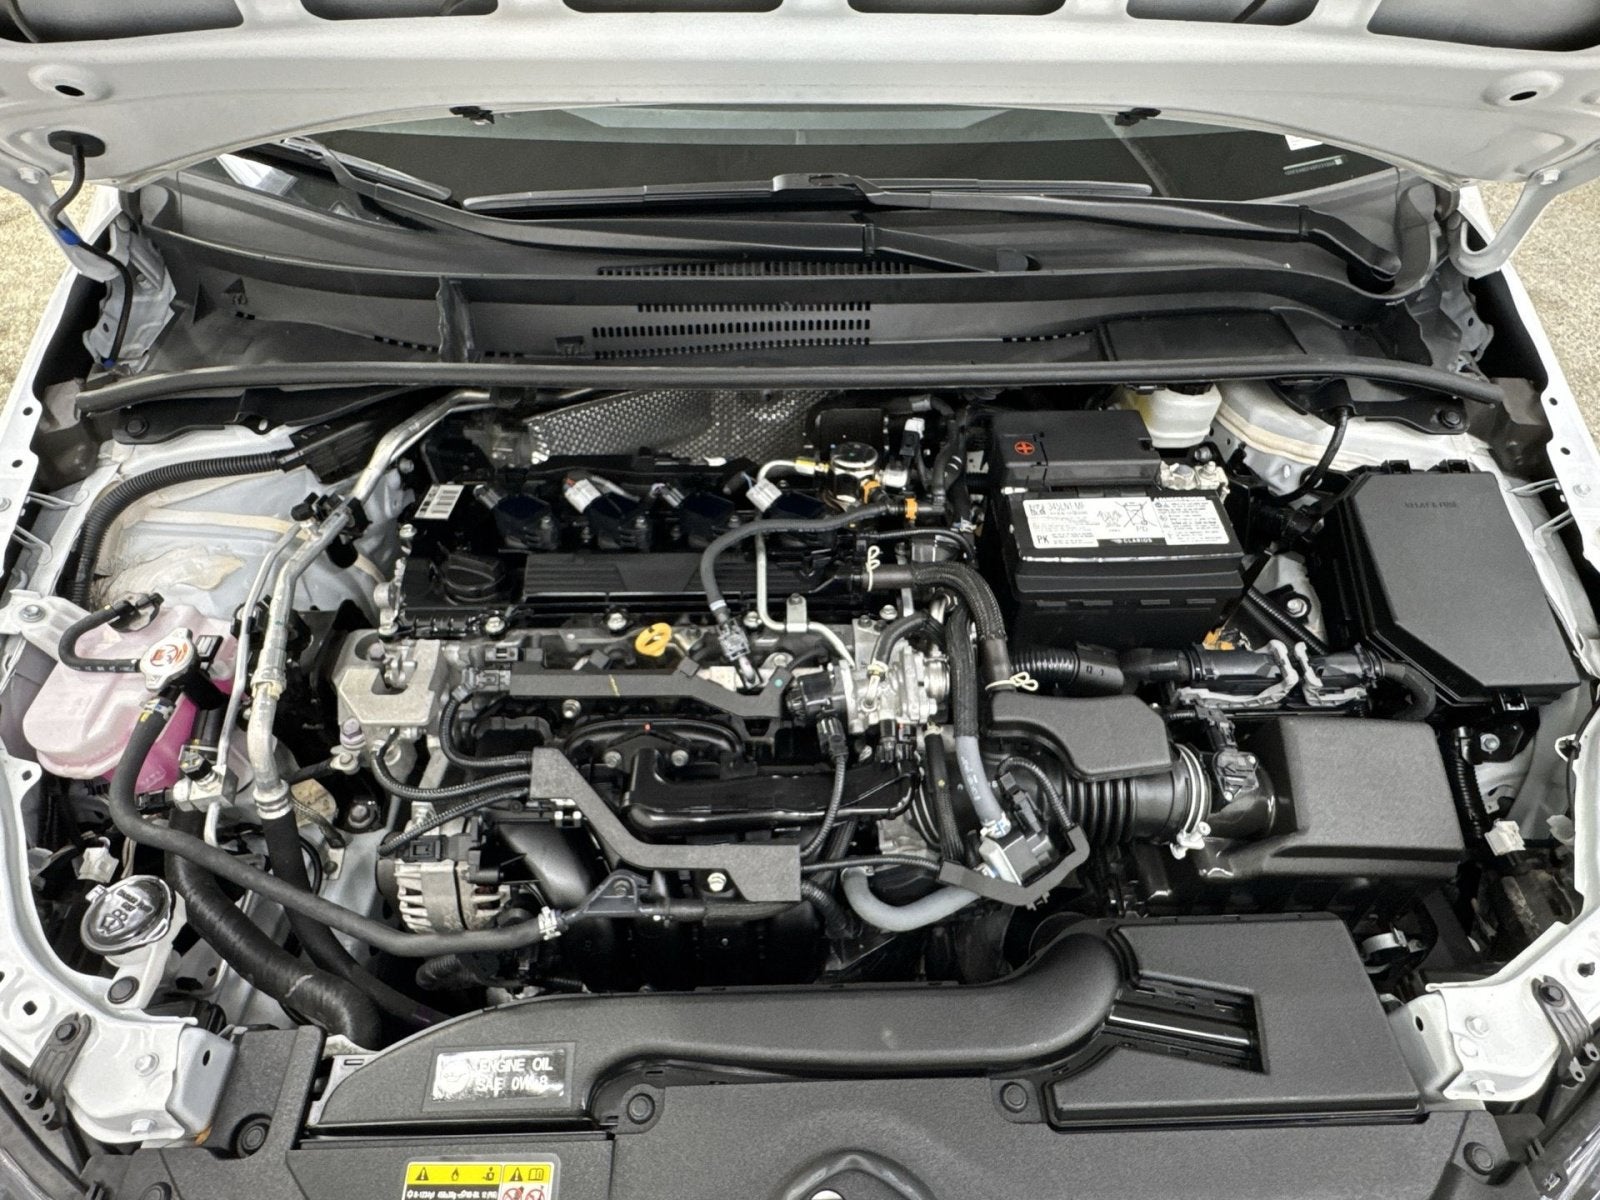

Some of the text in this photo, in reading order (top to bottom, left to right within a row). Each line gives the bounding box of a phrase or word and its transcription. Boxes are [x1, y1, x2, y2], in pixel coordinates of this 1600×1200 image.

[479, 1057, 553, 1073] ENGINE OIL
[476, 1076, 503, 1092] SAE
